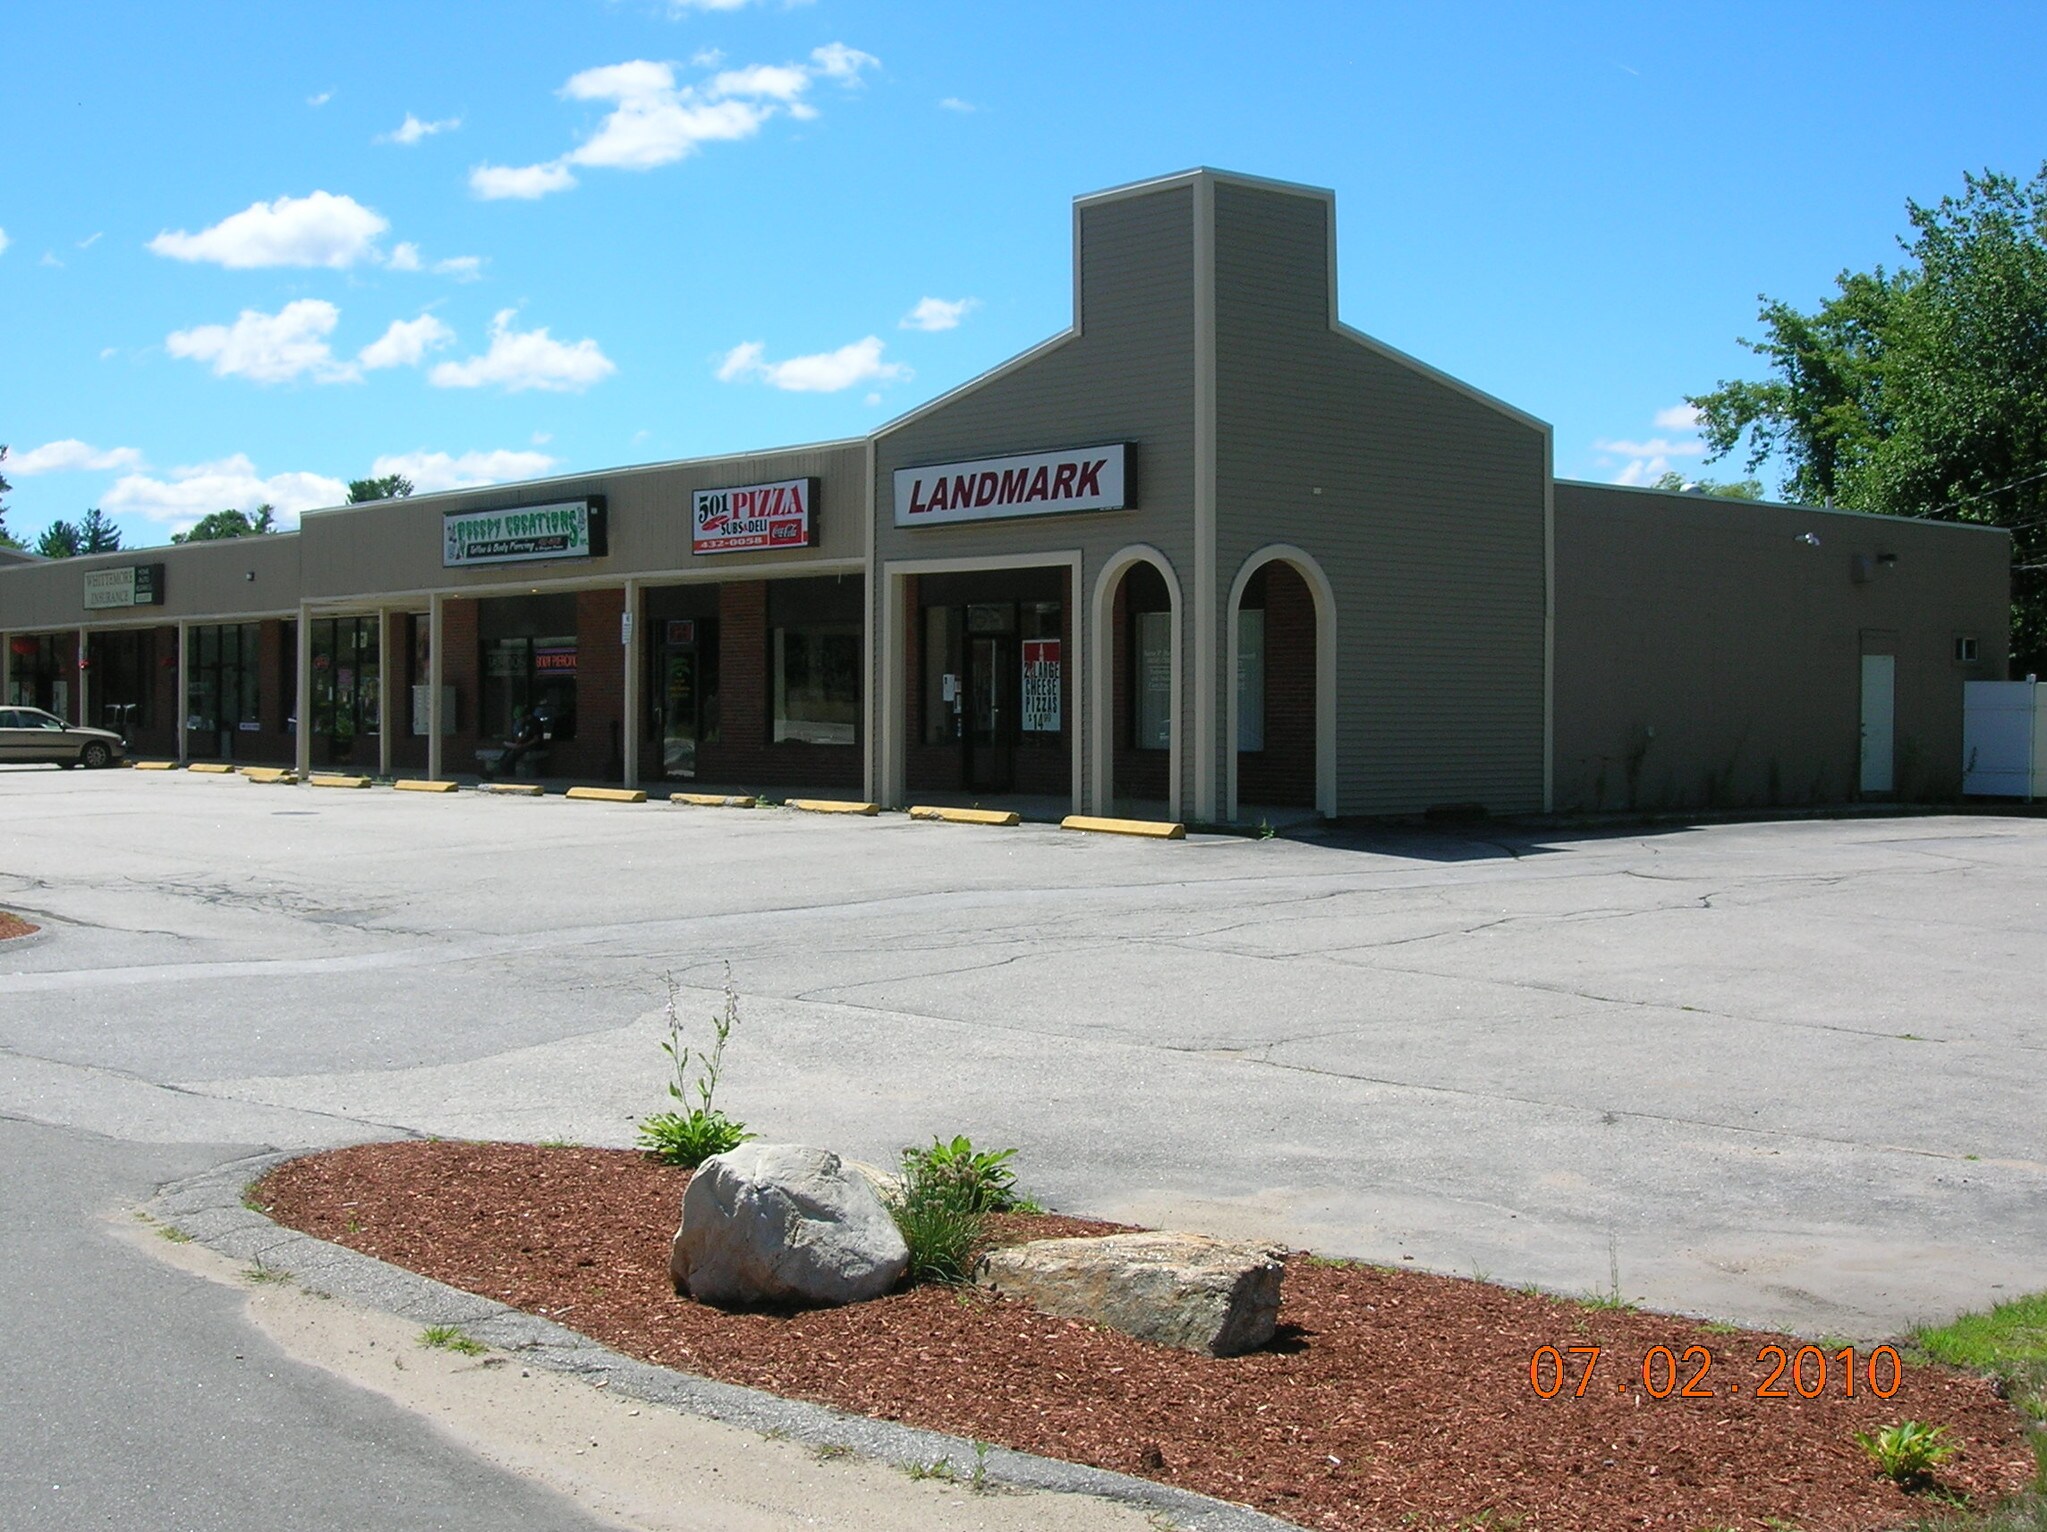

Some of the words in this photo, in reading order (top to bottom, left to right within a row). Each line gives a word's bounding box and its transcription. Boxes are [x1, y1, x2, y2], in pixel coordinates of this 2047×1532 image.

[908, 459, 1108, 513] LANDMARK
[699, 493, 729, 523] 501
[731, 485, 804, 520] PIZZA
[721, 521, 742, 535] SUBS
[748, 519, 767, 533] DELI
[700, 536, 763, 548] 432-0058
[1034, 662, 1059, 678] LARGE
[1025, 679, 1057, 695] CHEESE
[1026, 696, 1057, 713] PIZZAS
